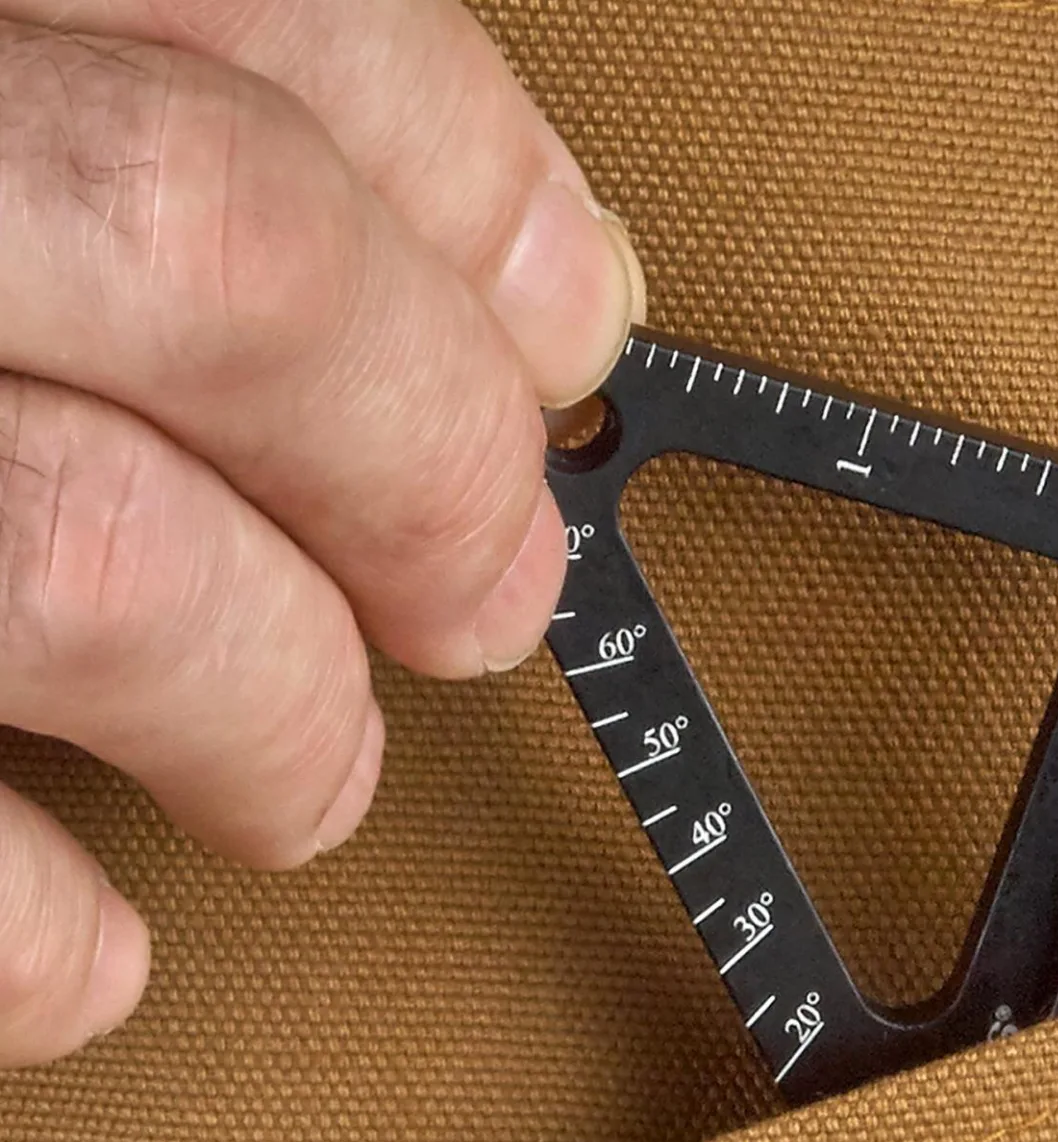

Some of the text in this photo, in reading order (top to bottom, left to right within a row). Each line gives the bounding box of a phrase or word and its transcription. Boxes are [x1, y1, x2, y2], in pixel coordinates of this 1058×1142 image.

[836, 460, 872, 478] 1
[565, 524, 595, 554] 0°
[599, 624, 647, 660] 60°
[643, 715, 689, 757] 50°
[692, 802, 732, 844] 40°
[733, 891, 774, 942] 30°
[784, 991, 821, 1043] 20°
